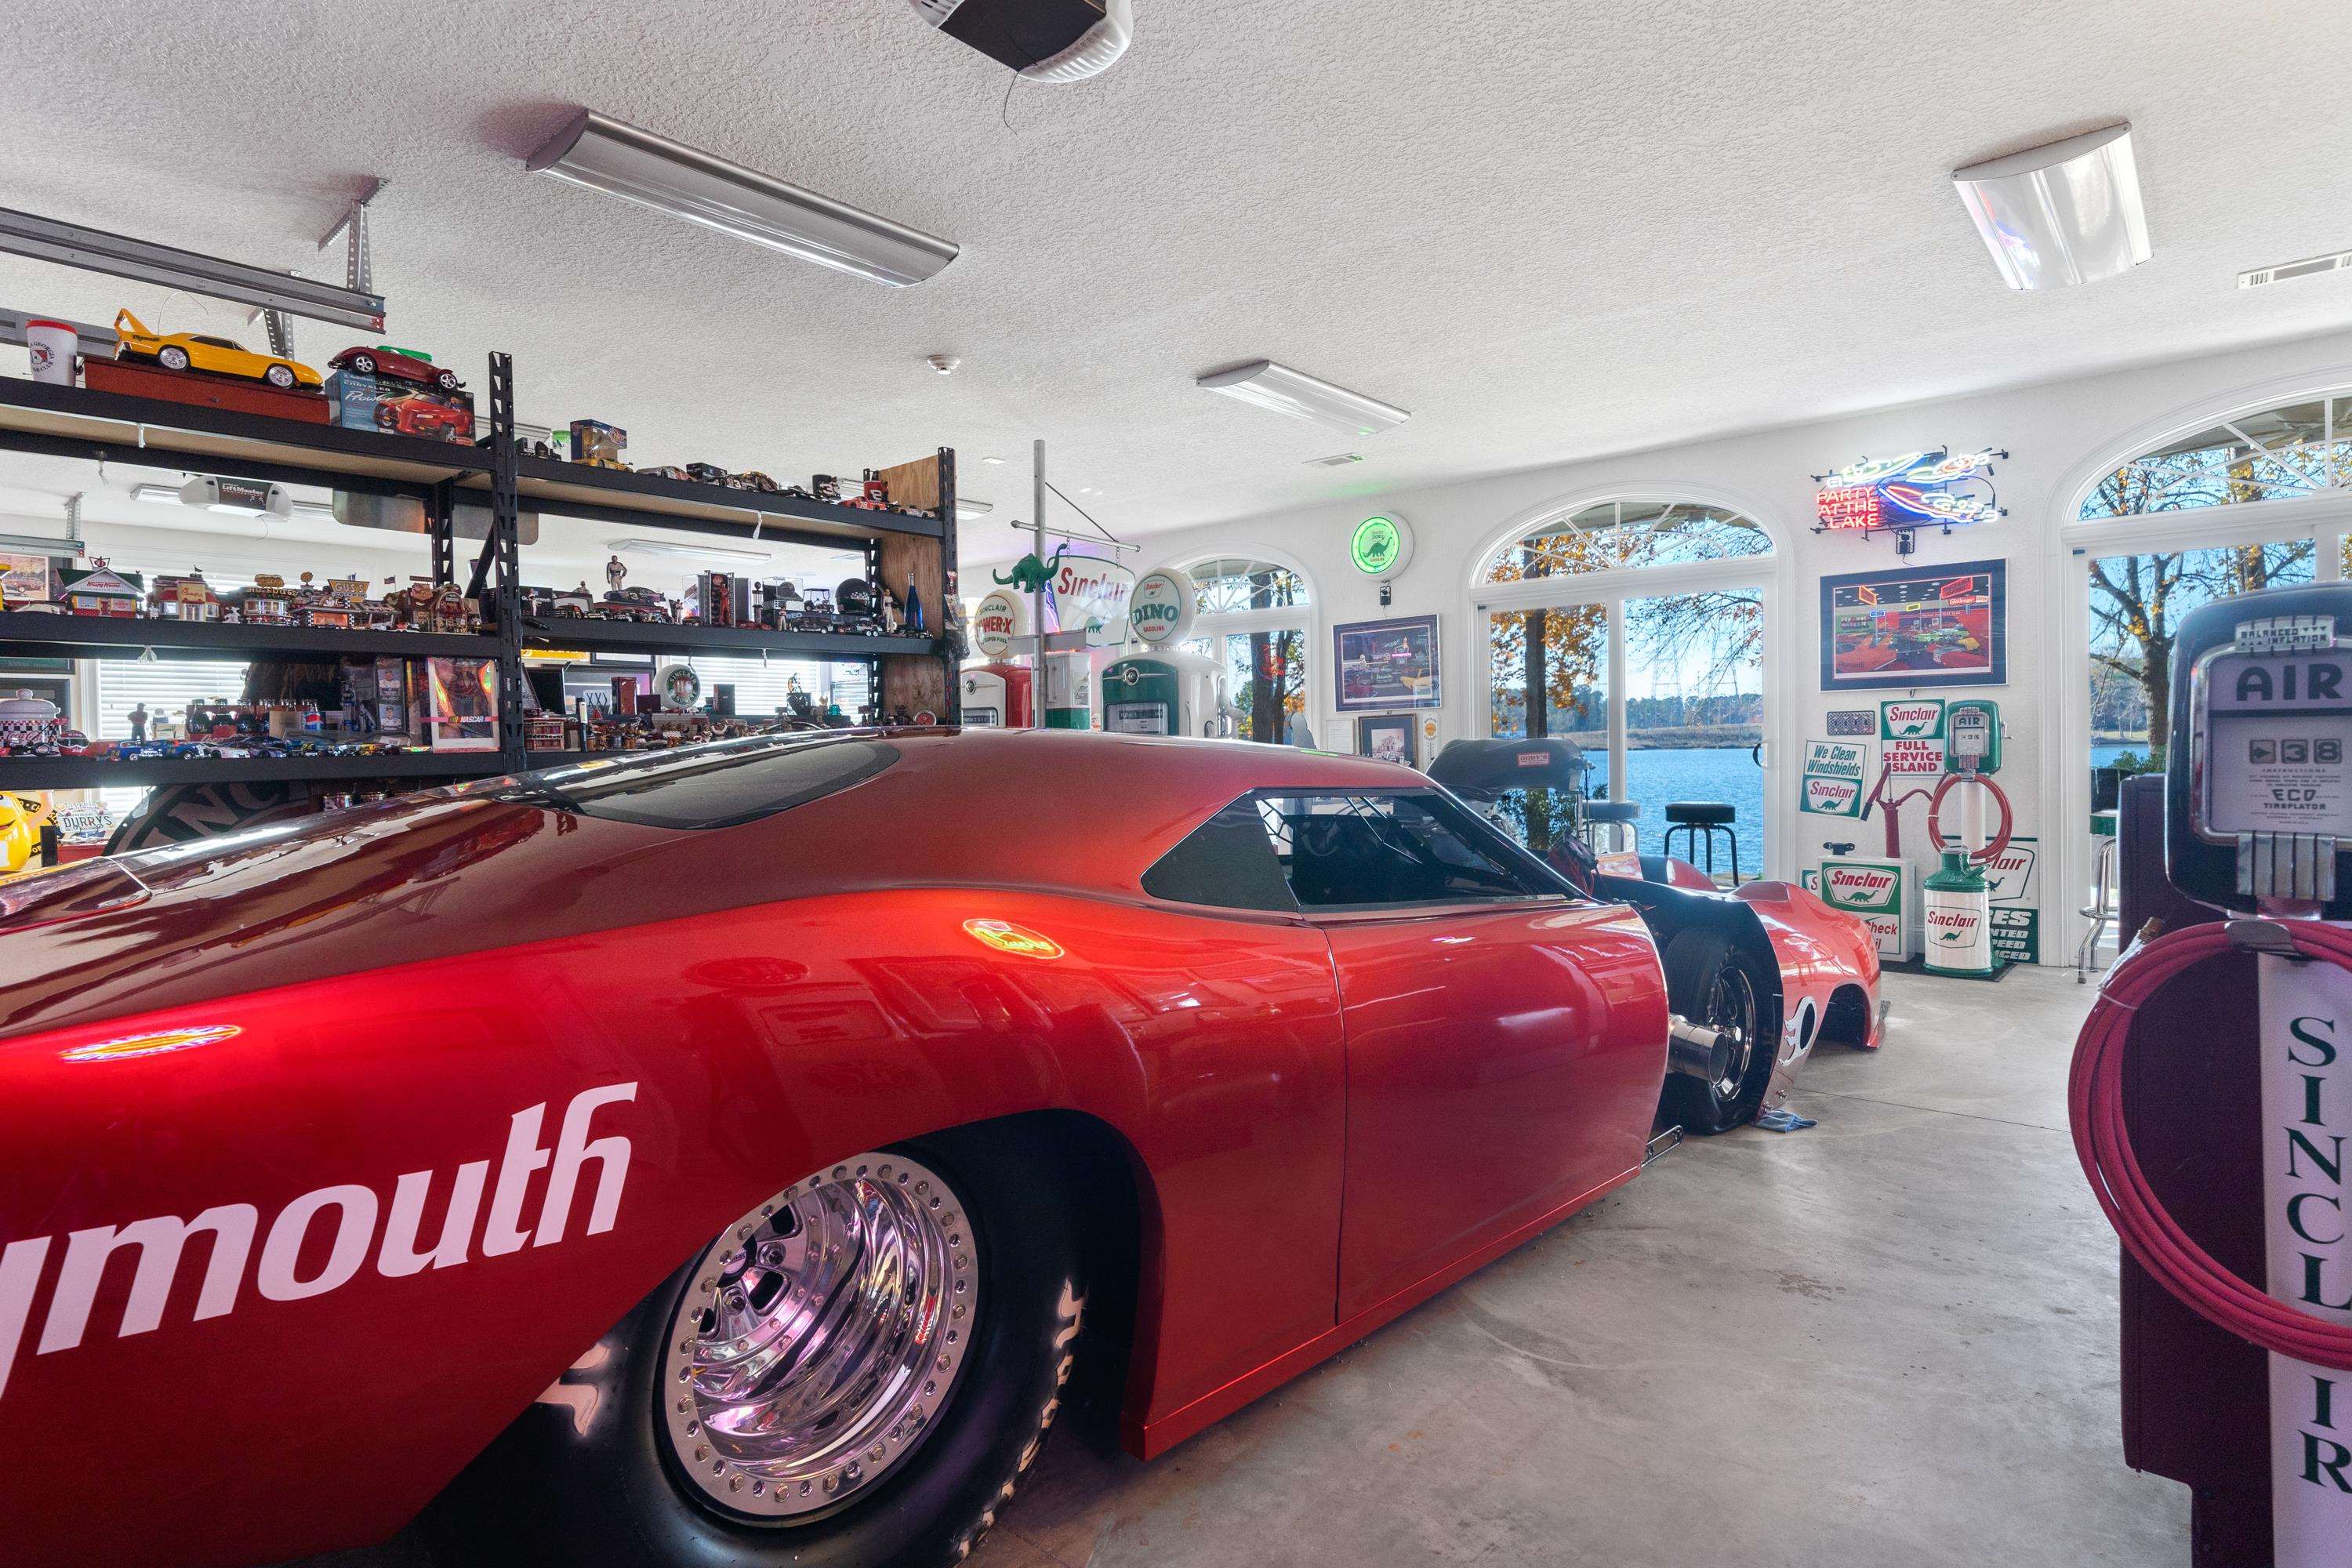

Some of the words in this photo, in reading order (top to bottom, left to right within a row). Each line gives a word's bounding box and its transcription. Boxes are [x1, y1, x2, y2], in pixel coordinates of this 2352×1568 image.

[344, 381, 390, 391] CHRYSLER
[345, 391, 394, 401] Prowler
[222, 483, 264, 495] LiftMaster
[1817, 486, 1873, 504] PARTY
[1818, 503, 1841, 516] AT
[1844, 499, 1878, 514] THE
[1830, 513, 1878, 529] LAKE
[1058, 567, 1126, 602] Sinclair
[980, 604, 1007, 615] SINCLAIR
[1131, 603, 1179, 626] DINO
[2241, 628, 2299, 639] BALANCED
[2267, 634, 2327, 645] INFLATION
[2236, 663, 2343, 702] AIR
[1889, 706, 1939, 721] Sinclair
[1958, 717, 1980, 726] AIR
[1813, 745, 1829, 759] We
[1831, 746, 1857, 761] Clean
[1895, 741, 1929, 751] FULL
[1883, 752, 1943, 762] SERVICE
[1807, 759, 1861, 777] Windshields
[1889, 762, 1938, 772] SLAND
[1810, 781, 1856, 799] Sinclair
[2272, 789, 2317, 801] ECO
[64, 815, 112, 829] DURRYS
[1991, 856, 2027, 871] lair
[1831, 870, 1892, 888] Sinclair
[1927, 910, 1977, 927] Sinclair
[1989, 909, 2032, 926] ES
[1990, 928, 2029, 938] NTED
[2283, 1017, 2352, 1494] SINCLIR
